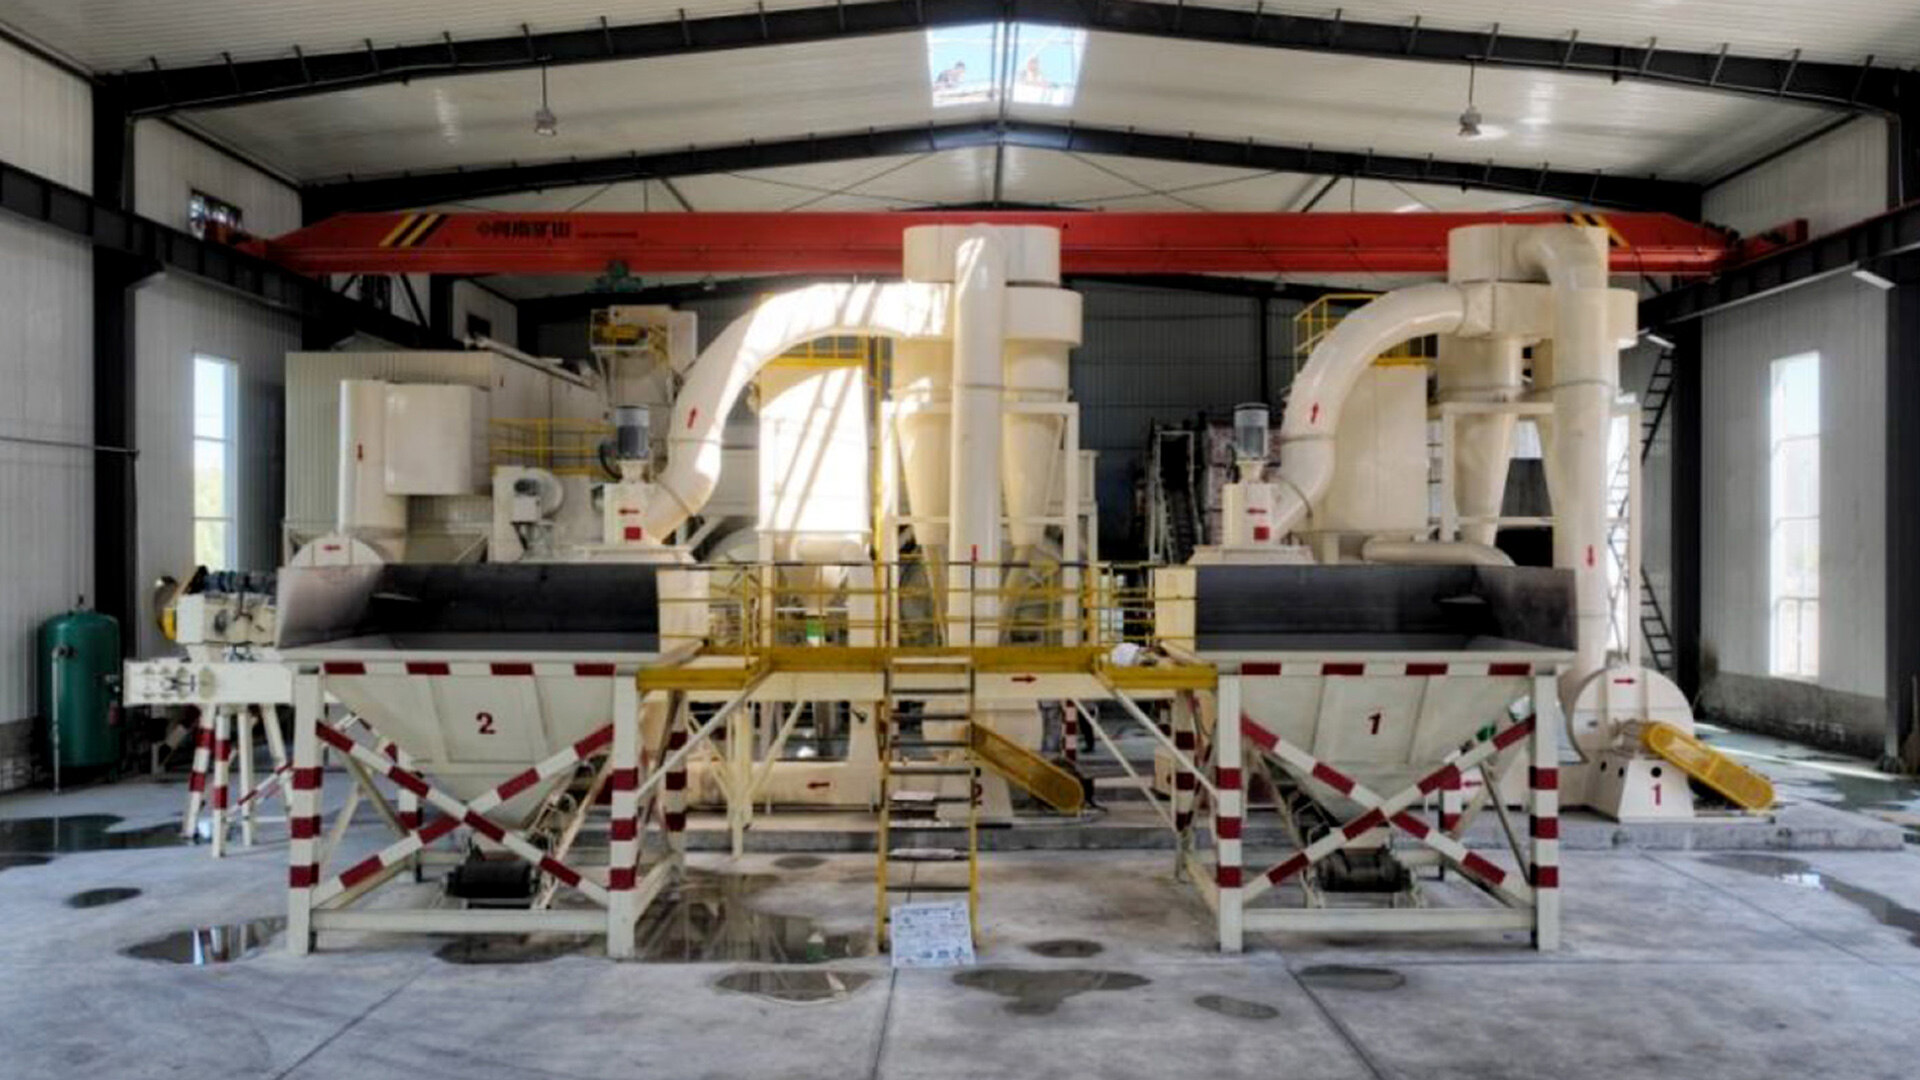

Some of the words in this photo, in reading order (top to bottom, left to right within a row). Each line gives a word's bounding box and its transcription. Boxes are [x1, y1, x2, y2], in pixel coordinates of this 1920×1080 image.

[476, 712, 496, 735] 2
[1368, 712, 1381, 735] 1
[1650, 783, 1662, 806] 1
